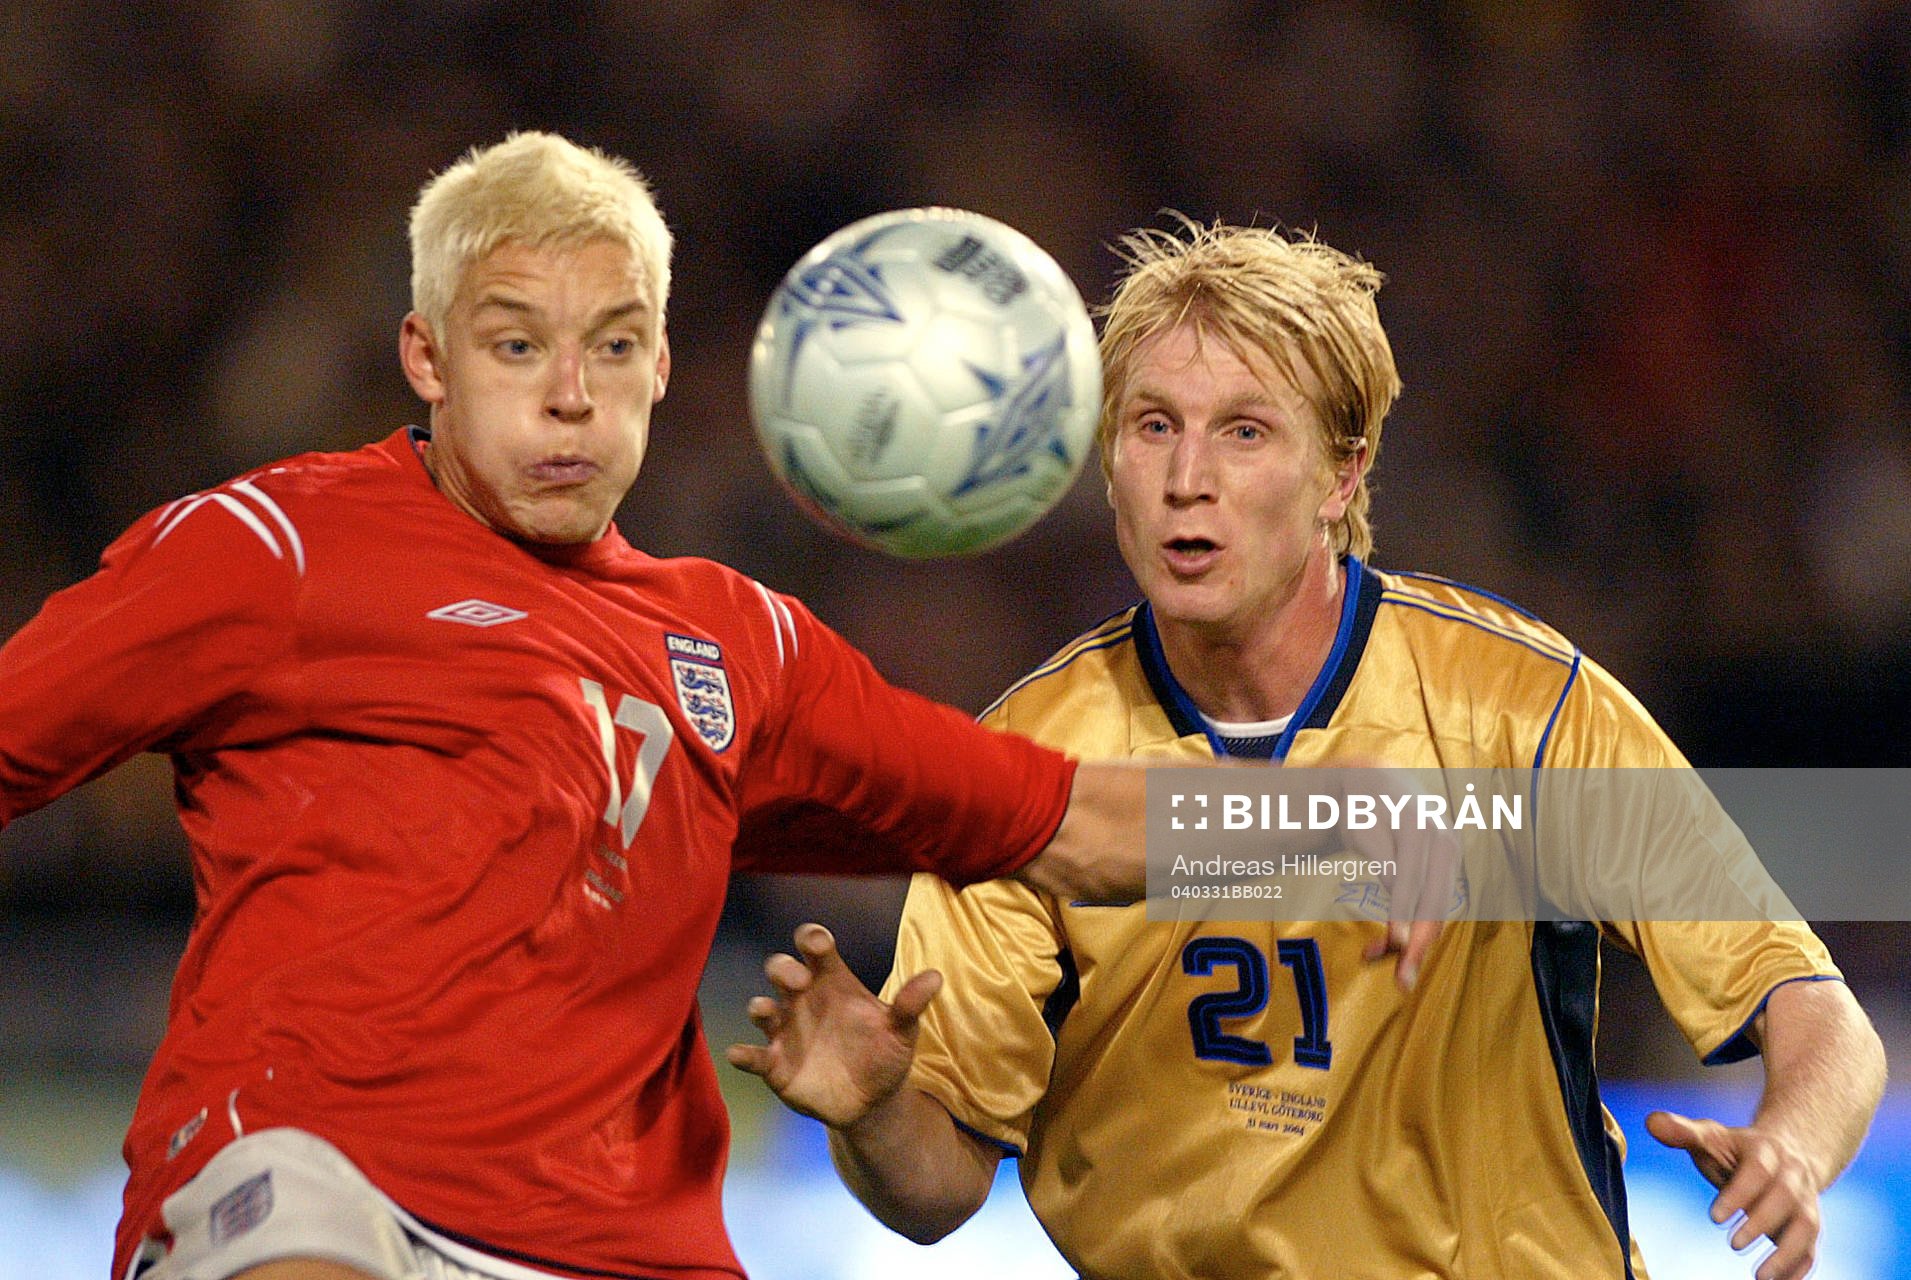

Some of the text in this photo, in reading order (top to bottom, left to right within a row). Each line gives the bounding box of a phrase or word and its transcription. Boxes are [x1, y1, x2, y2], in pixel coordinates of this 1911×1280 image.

[667, 635, 720, 660] ENGLAND
[579, 677, 674, 849] 17
[1182, 937, 1332, 1070] 21
[1229, 1081, 1271, 1100] SVERIGE
[1281, 1091, 1327, 1108] ENGLAND
